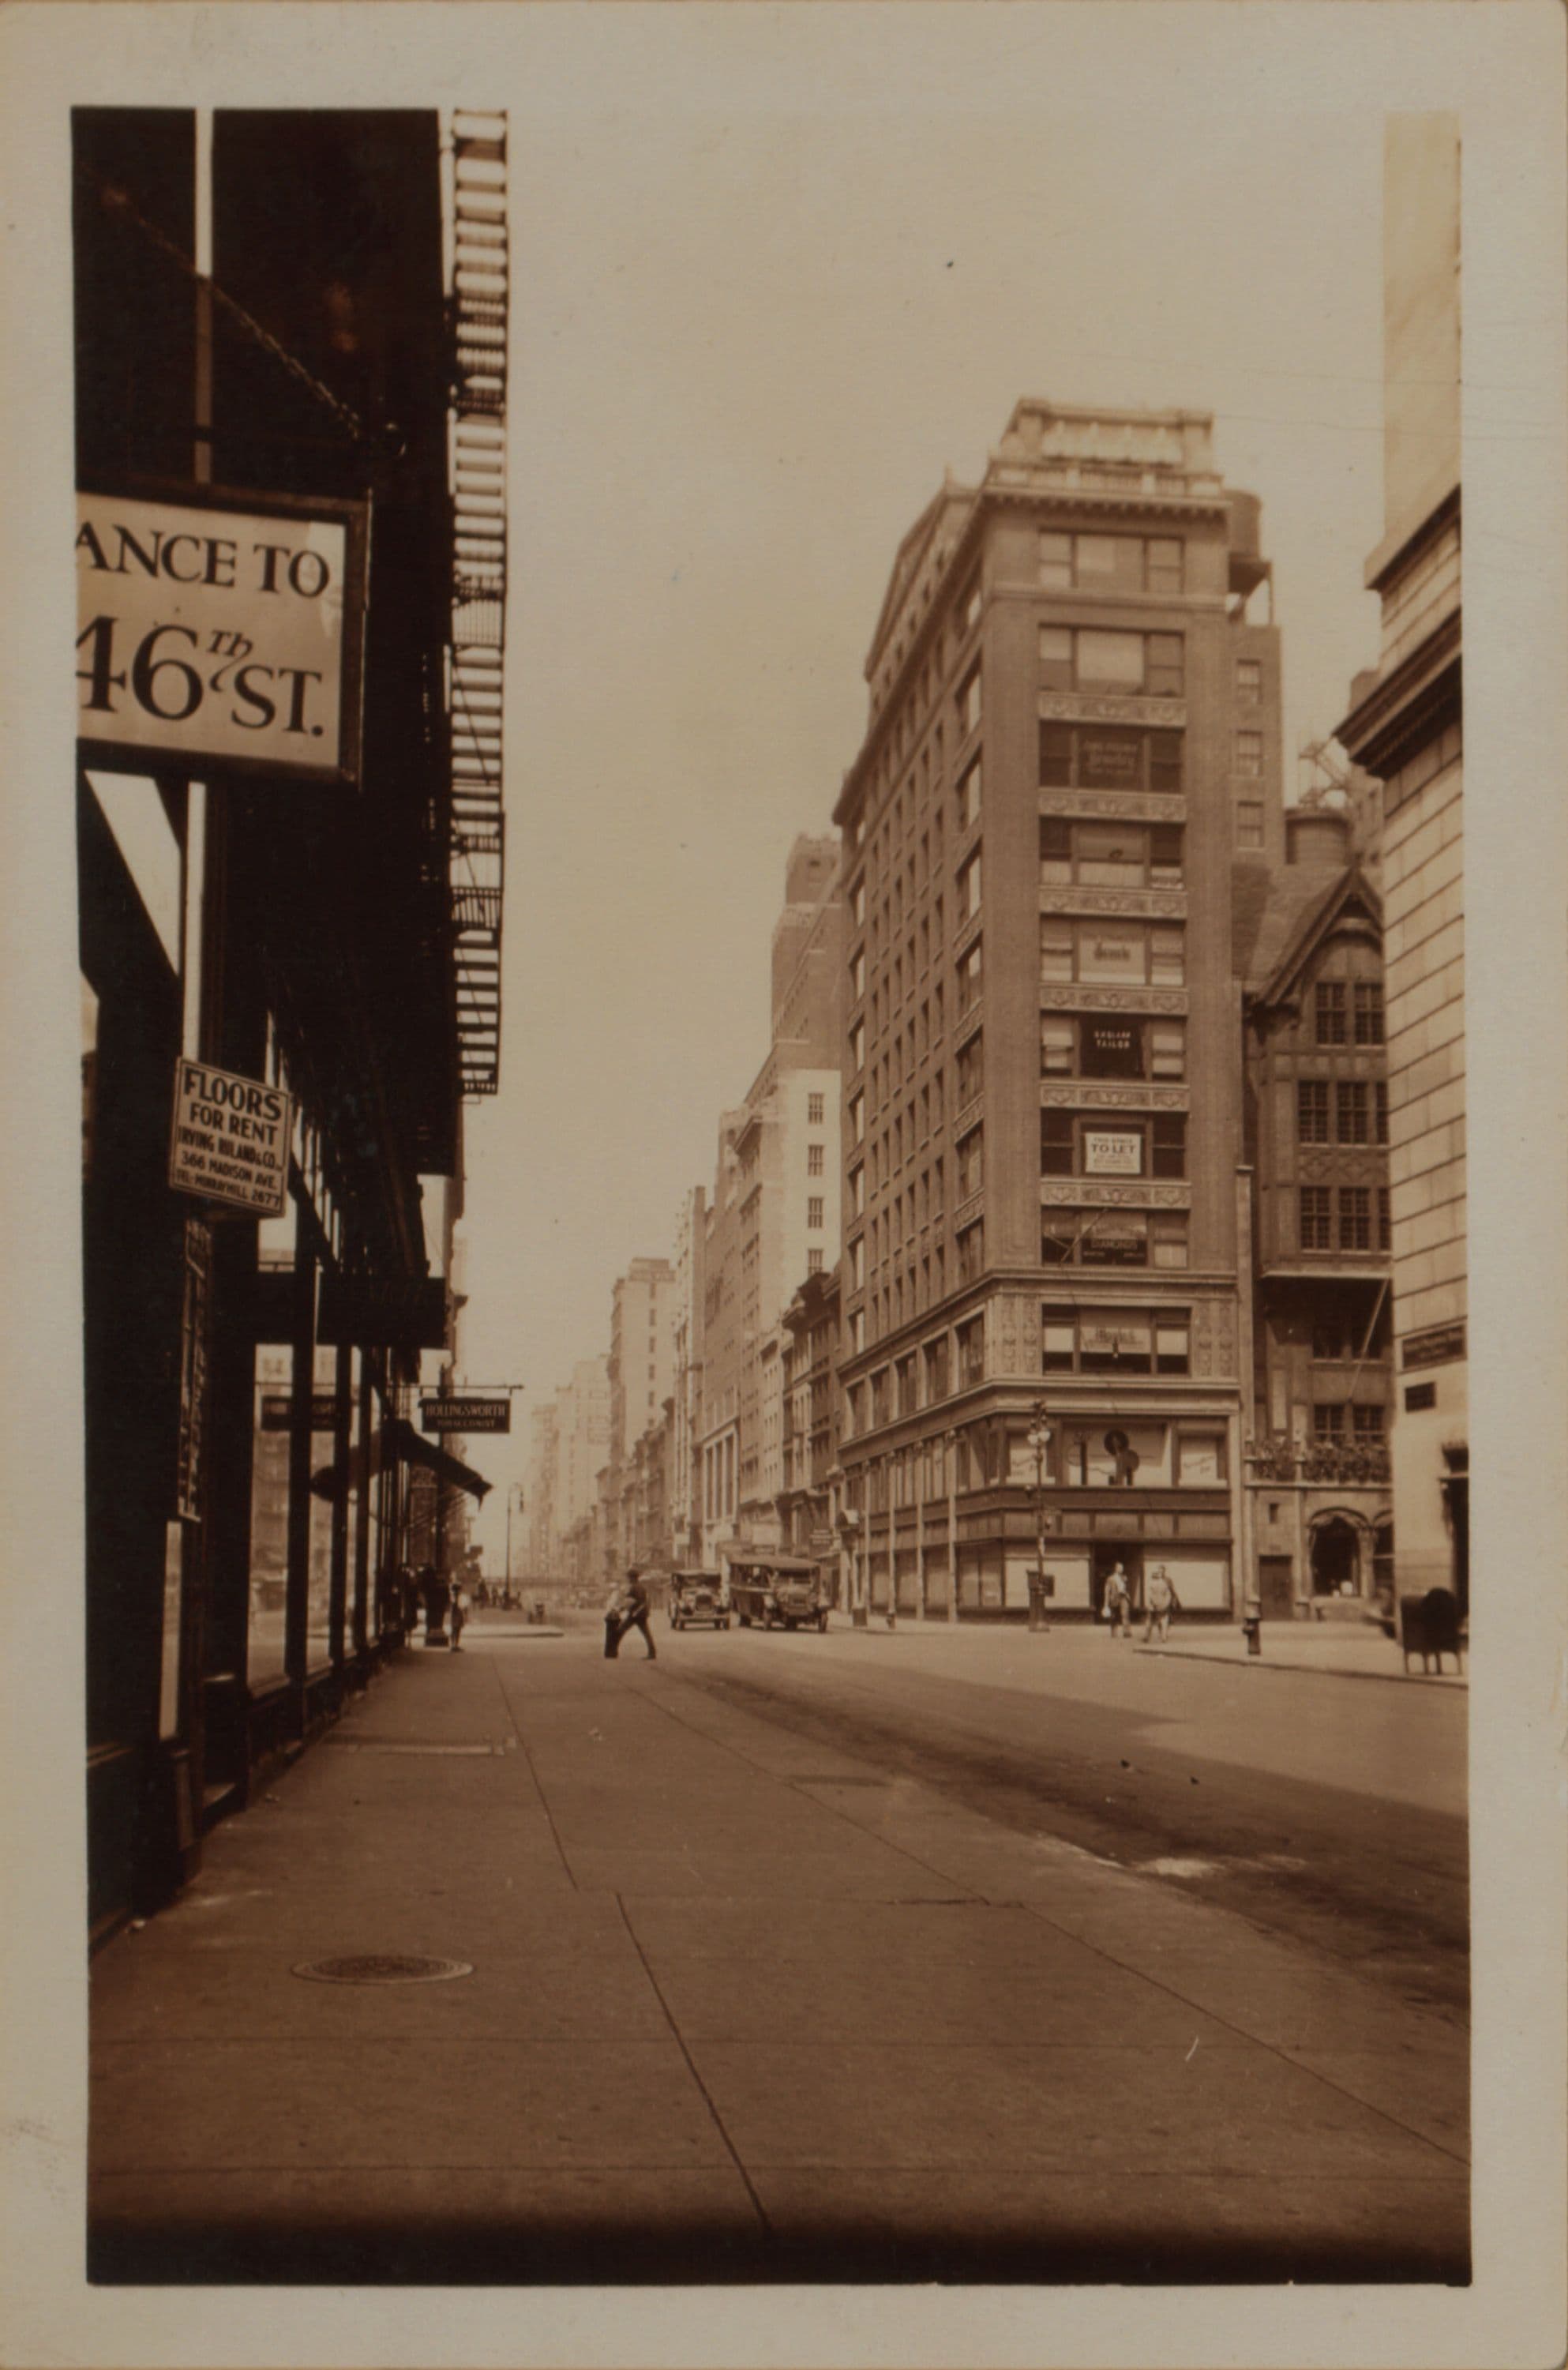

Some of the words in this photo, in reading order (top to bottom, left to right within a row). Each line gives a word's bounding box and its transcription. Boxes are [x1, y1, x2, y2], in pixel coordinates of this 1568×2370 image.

[76, 521, 237, 588] ANCE
[253, 543, 330, 599] TO
[231, 664, 324, 738] ST.
[183, 1068, 282, 1121] FLOORS
[178, 1125, 215, 1152] IRVING
[189, 1102, 223, 1130] FOR
[229, 1114, 278, 1145] RENT
[1090, 1144, 1108, 1153] TO
[1112, 1144, 1136, 1154] LET
[208, 1159, 252, 1182] MADISON
[426, 1403, 505, 1417] HOLLINGSWORTH
